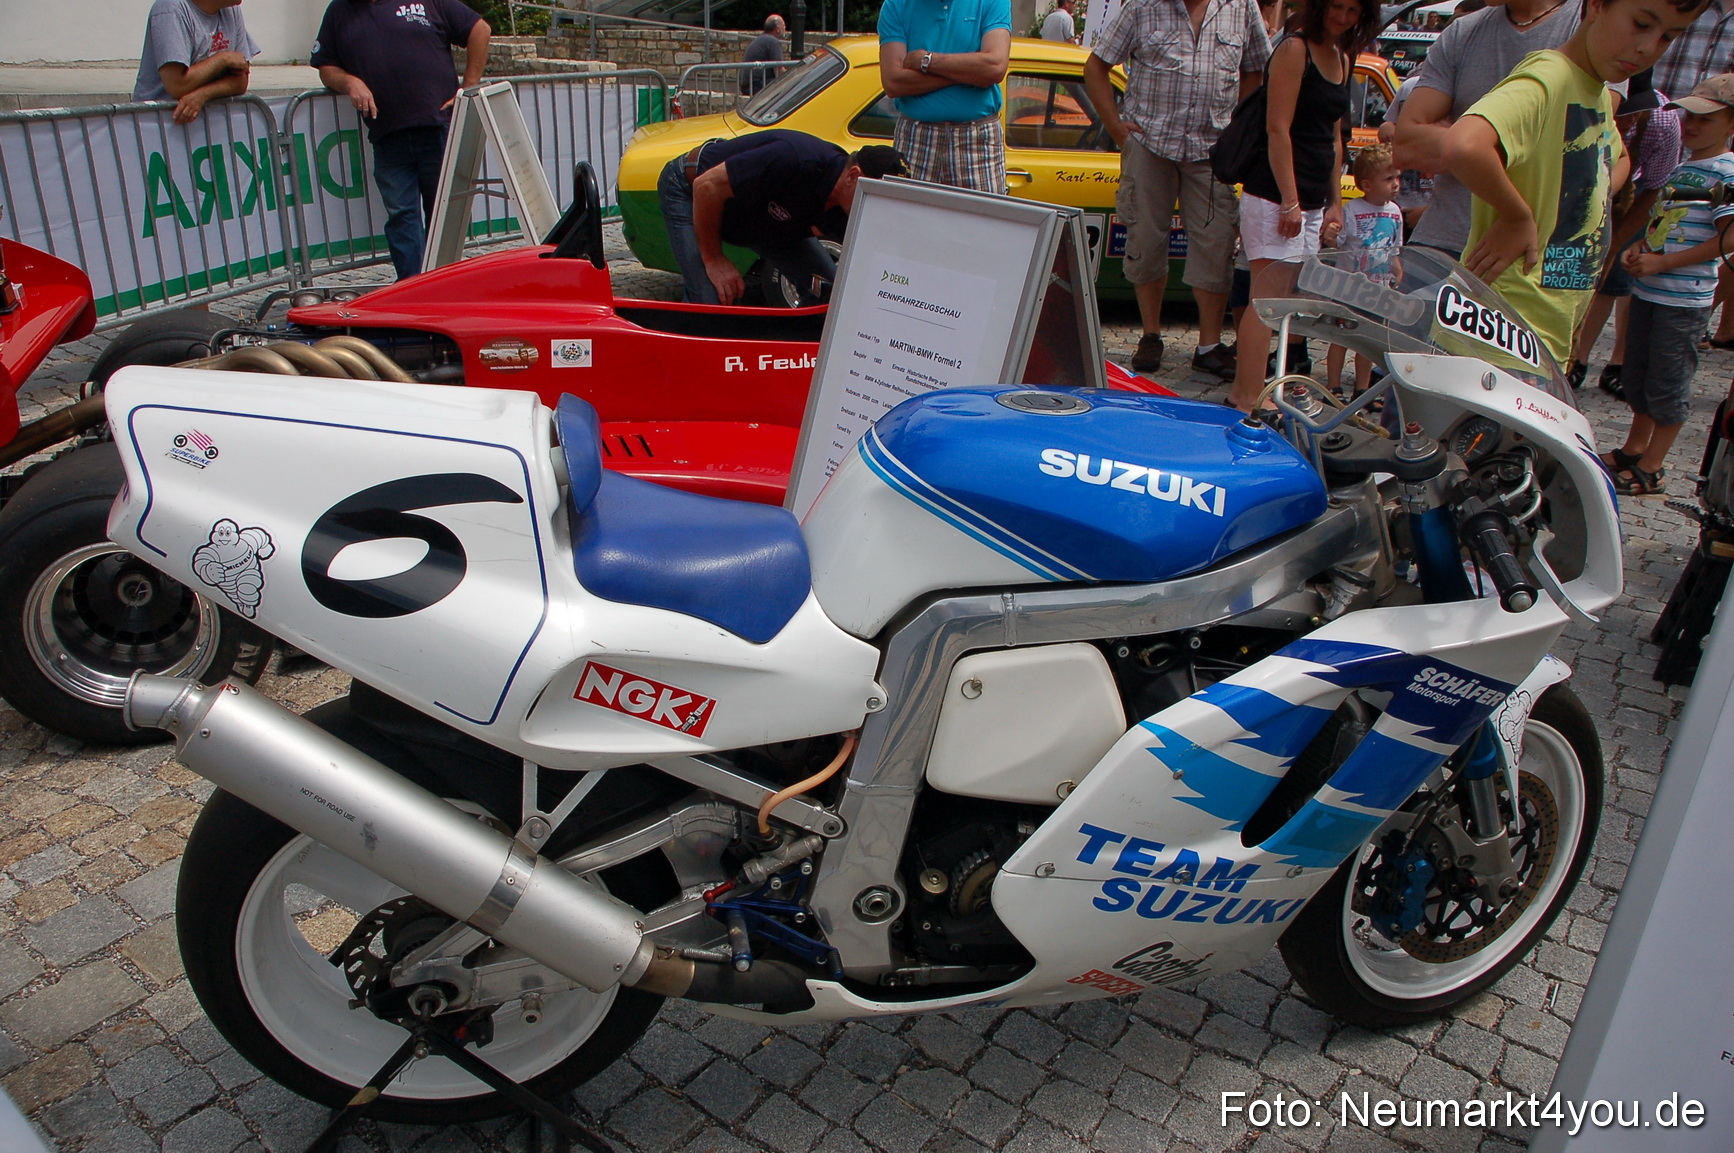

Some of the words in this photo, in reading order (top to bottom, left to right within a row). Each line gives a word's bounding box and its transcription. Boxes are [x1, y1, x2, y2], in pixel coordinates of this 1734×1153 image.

[1543, 261, 1581, 273] WAVE
[1545, 246, 1586, 259] NEON
[889, 273, 910, 286] DEKRA
[1542, 275, 1593, 289] PROJECT
[877, 289, 962, 319] RENNFAHRZEUGSCHAU
[1437, 285, 1540, 365] Castrol
[725, 356, 749, 372] R.
[889, 338, 934, 361] MARTINI-BMW
[933, 352, 957, 369] Formel
[956, 360, 963, 370] 2
[169, 447, 212, 466] SUPERBIKE
[1038, 448, 1227, 517] SUZUKI
[227, 549, 254, 571] MICHELIN
[300, 472, 524, 619] 6
[578, 665, 694, 729] NGK
[1405, 681, 1461, 707] Motorsport
[1413, 666, 1507, 707] SCHÄFER
[300, 787, 315, 798] NOT
[313, 795, 327, 806] FOR
[326, 802, 344, 815] ROAD
[343, 811, 356, 822] USE
[1075, 822, 1262, 894] TEAM
[1092, 877, 1307, 925] SUZUKI
